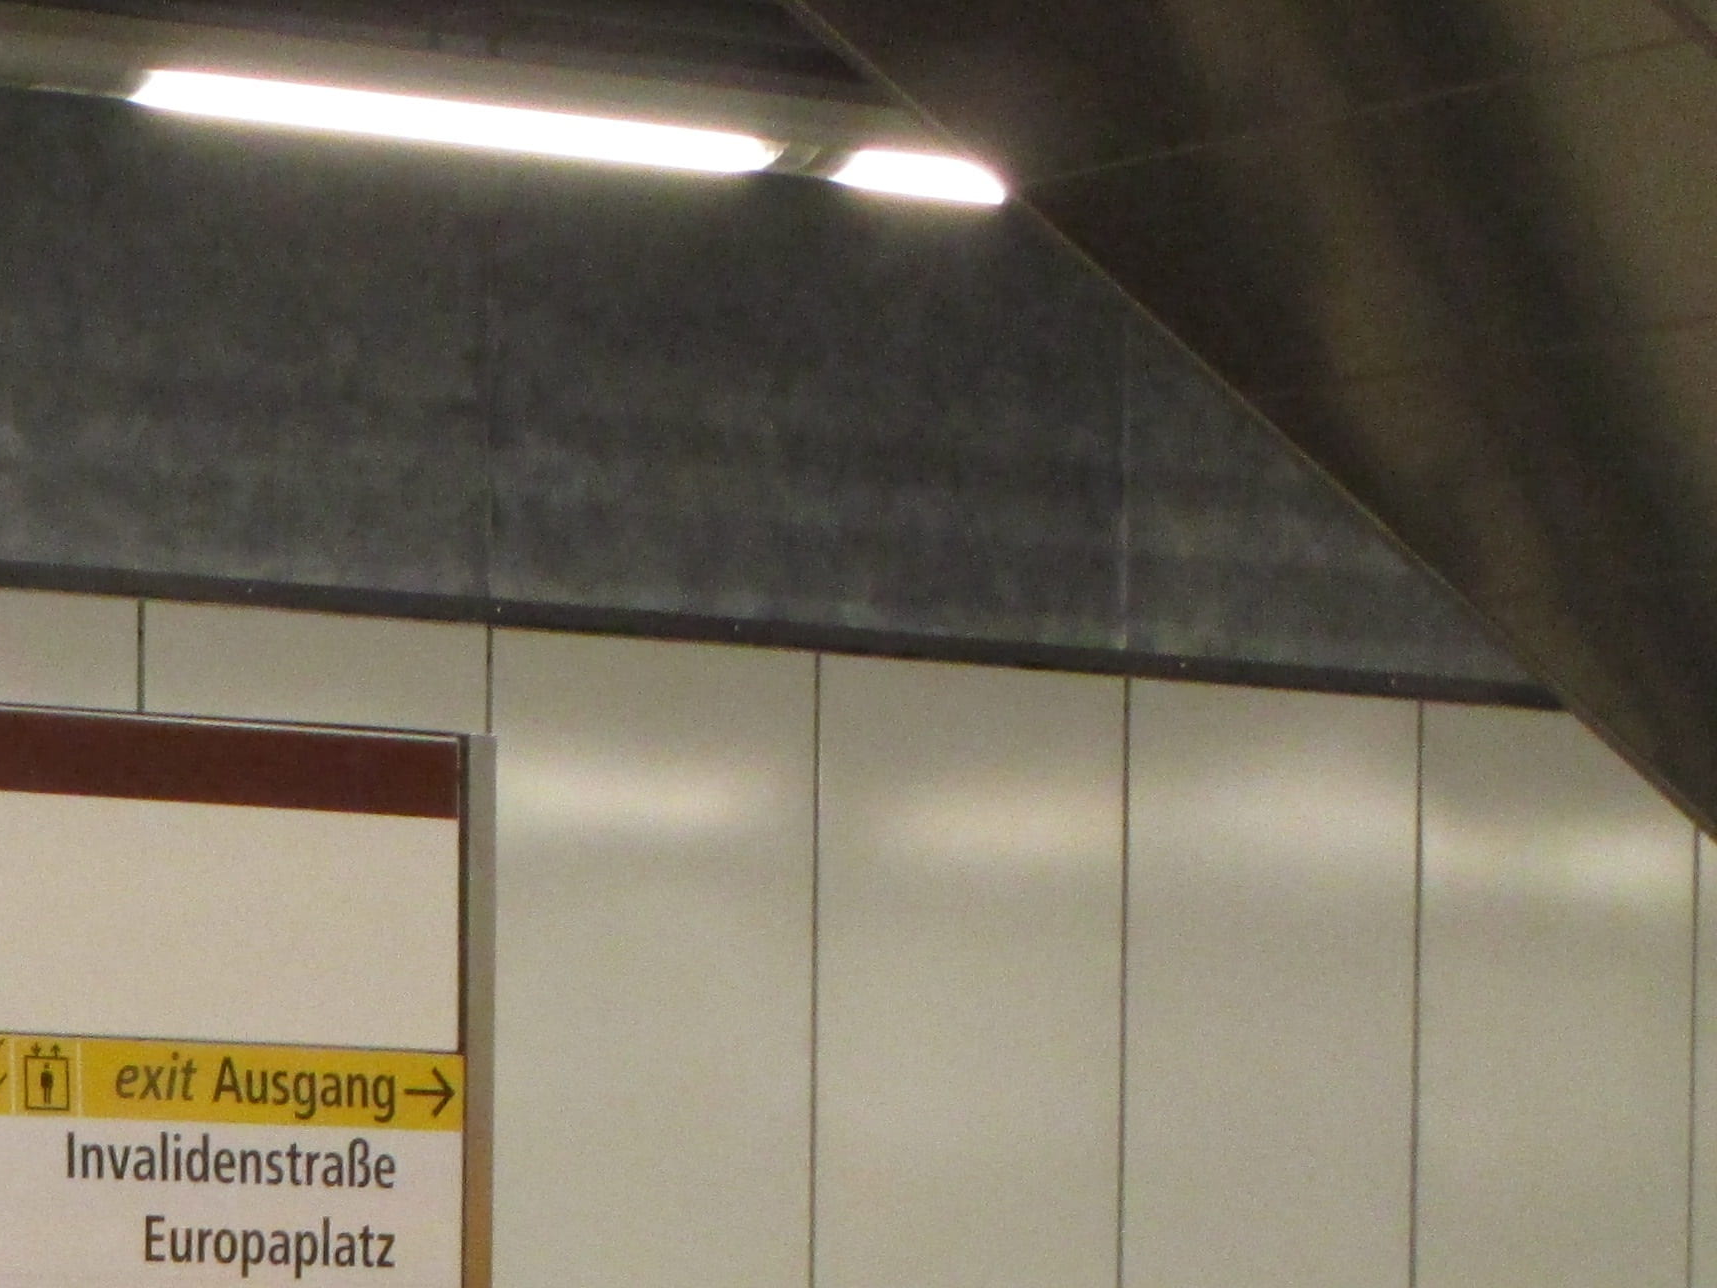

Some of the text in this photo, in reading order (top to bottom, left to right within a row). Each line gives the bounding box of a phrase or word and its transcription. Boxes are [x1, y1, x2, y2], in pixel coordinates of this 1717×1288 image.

[115, 1055, 398, 1122] exit Ausgang
[67, 1130, 397, 1189] Invalidenstraße
[144, 1215, 397, 1278] Europaplatz
